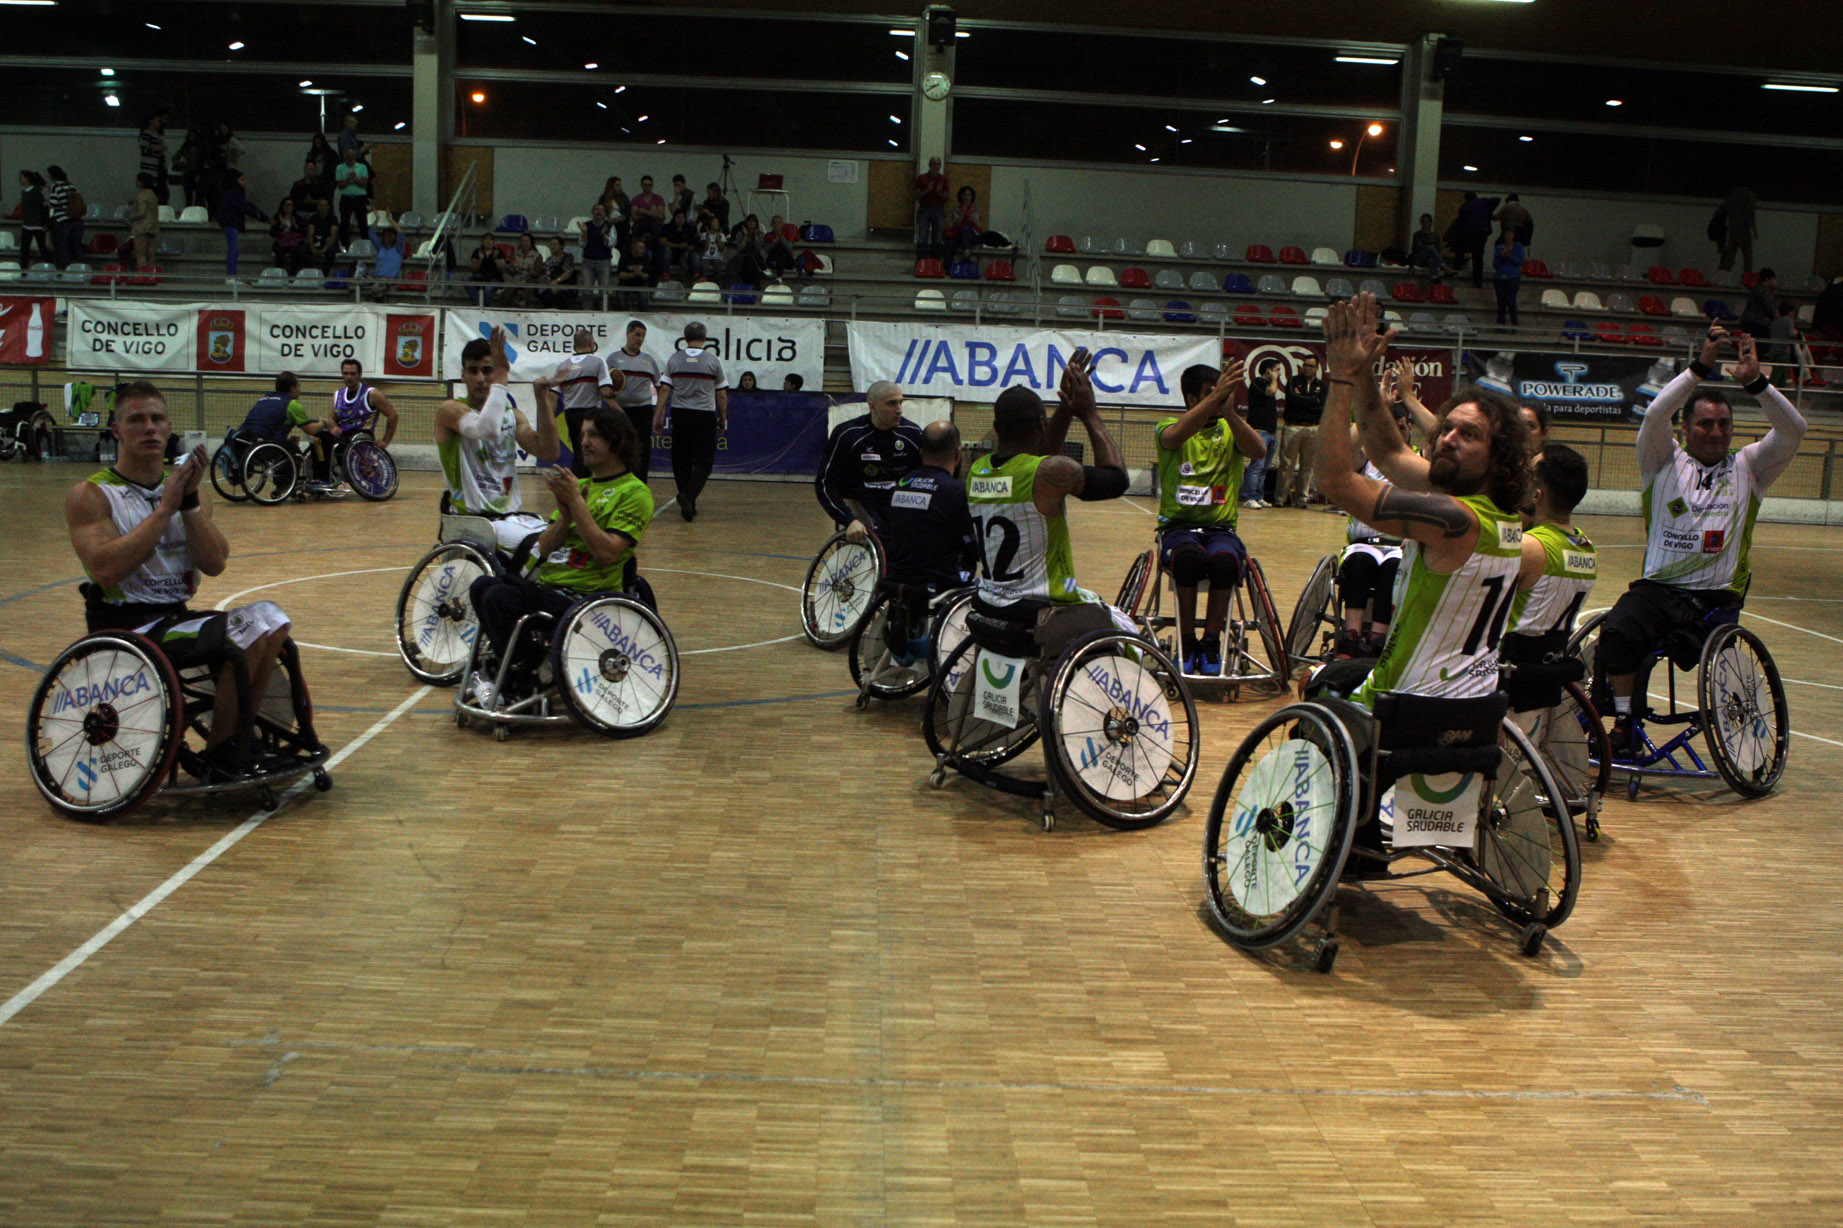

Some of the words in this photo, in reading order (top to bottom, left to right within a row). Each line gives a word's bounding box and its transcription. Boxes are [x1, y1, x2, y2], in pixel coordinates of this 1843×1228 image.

[81, 319, 179, 337] CONCELLO
[270, 324, 366, 340] CONCELLO
[92, 338, 116, 353] DE
[123, 340, 166, 355] VIGO
[281, 343, 305, 357] DE
[311, 343, 355, 358] VIGO
[1522, 383, 1620, 399] POWERADE
[1553, 403, 1573, 414] para
[1574, 402, 1622, 416] deportistas
[971, 515, 1025, 580] 12
[100, 747, 142, 764] DEPORTE
[101, 758, 138, 774] GALEGO
[1102, 760, 1133, 787] GALEGO
[1105, 751, 1141, 782] DEPORTE
[1407, 808, 1454, 821] GALICIA
[1406, 820, 1465, 833] SAUDABLE
